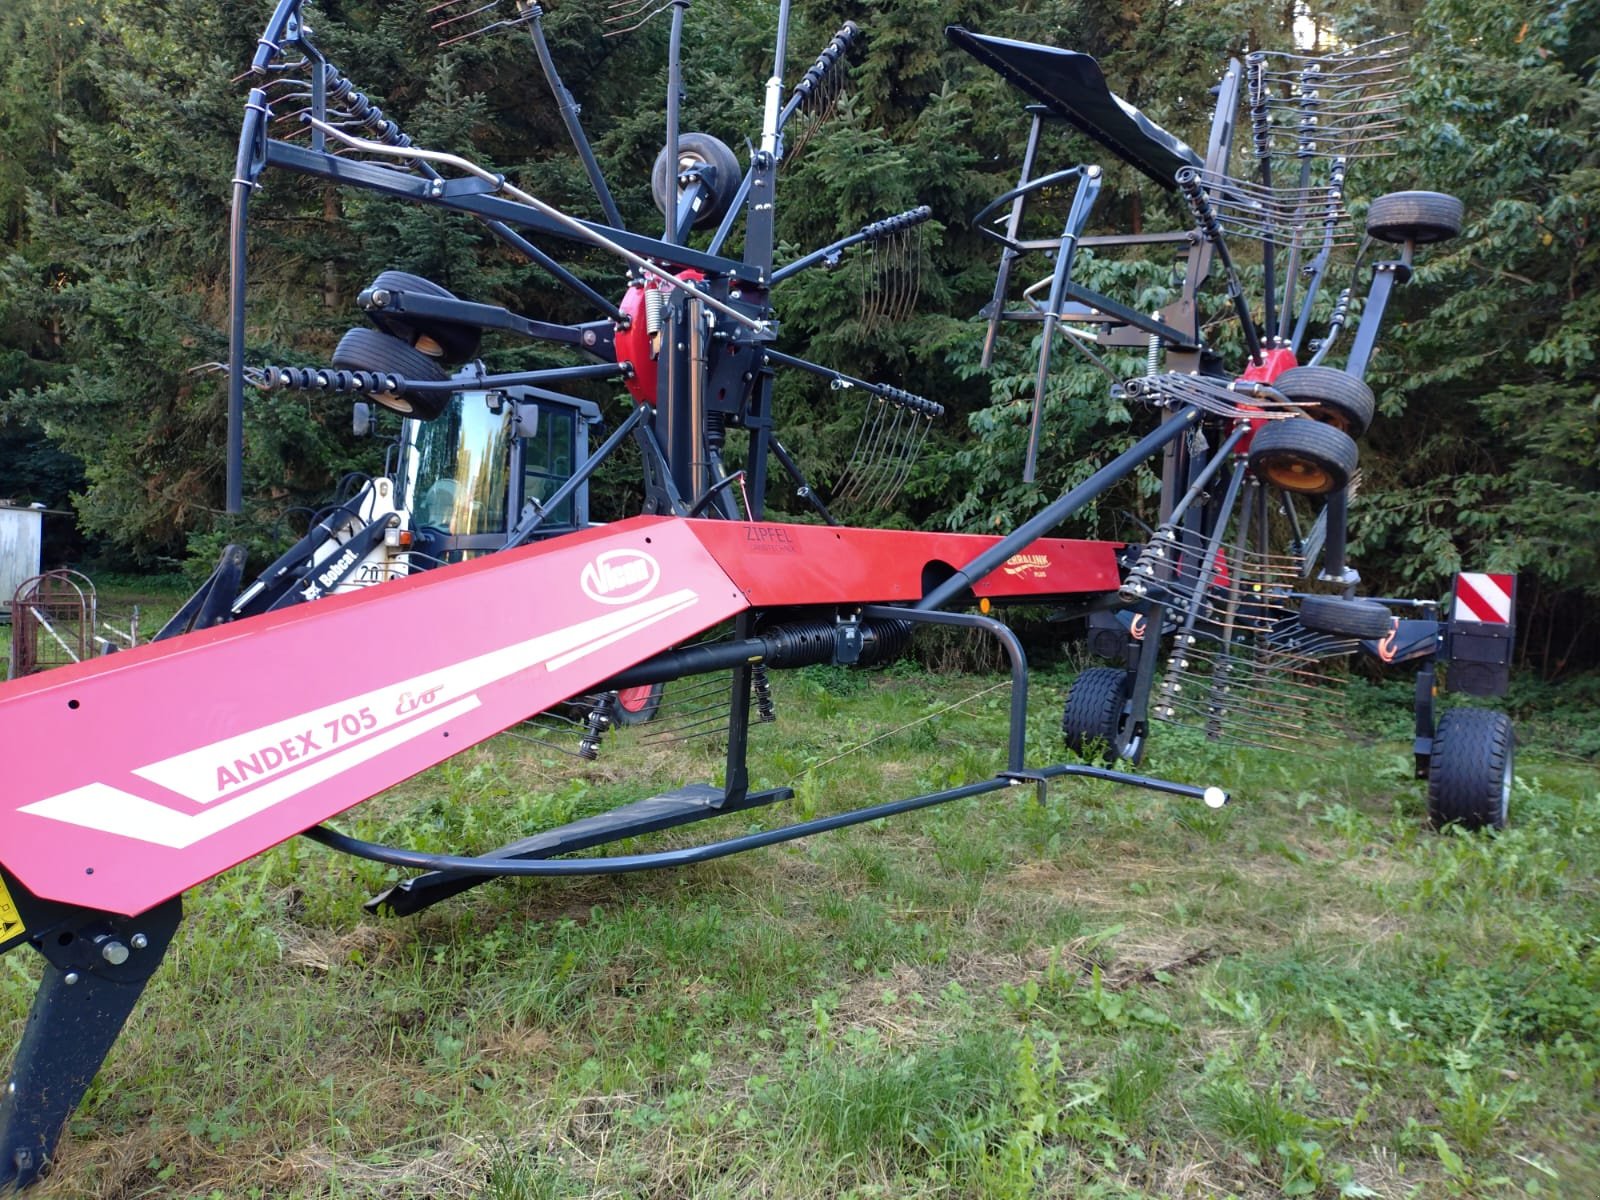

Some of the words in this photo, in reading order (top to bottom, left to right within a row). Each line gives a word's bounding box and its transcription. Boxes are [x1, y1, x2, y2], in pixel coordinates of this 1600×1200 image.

[743, 526, 793, 543] ZIPFEL
[318, 548, 358, 588] Bobcat
[360, 565, 379, 584] 20
[593, 556, 649, 594] Vicon
[215, 730, 322, 791] ANDEX
[324, 707, 377, 743] 705
[395, 684, 444, 716] Evo
